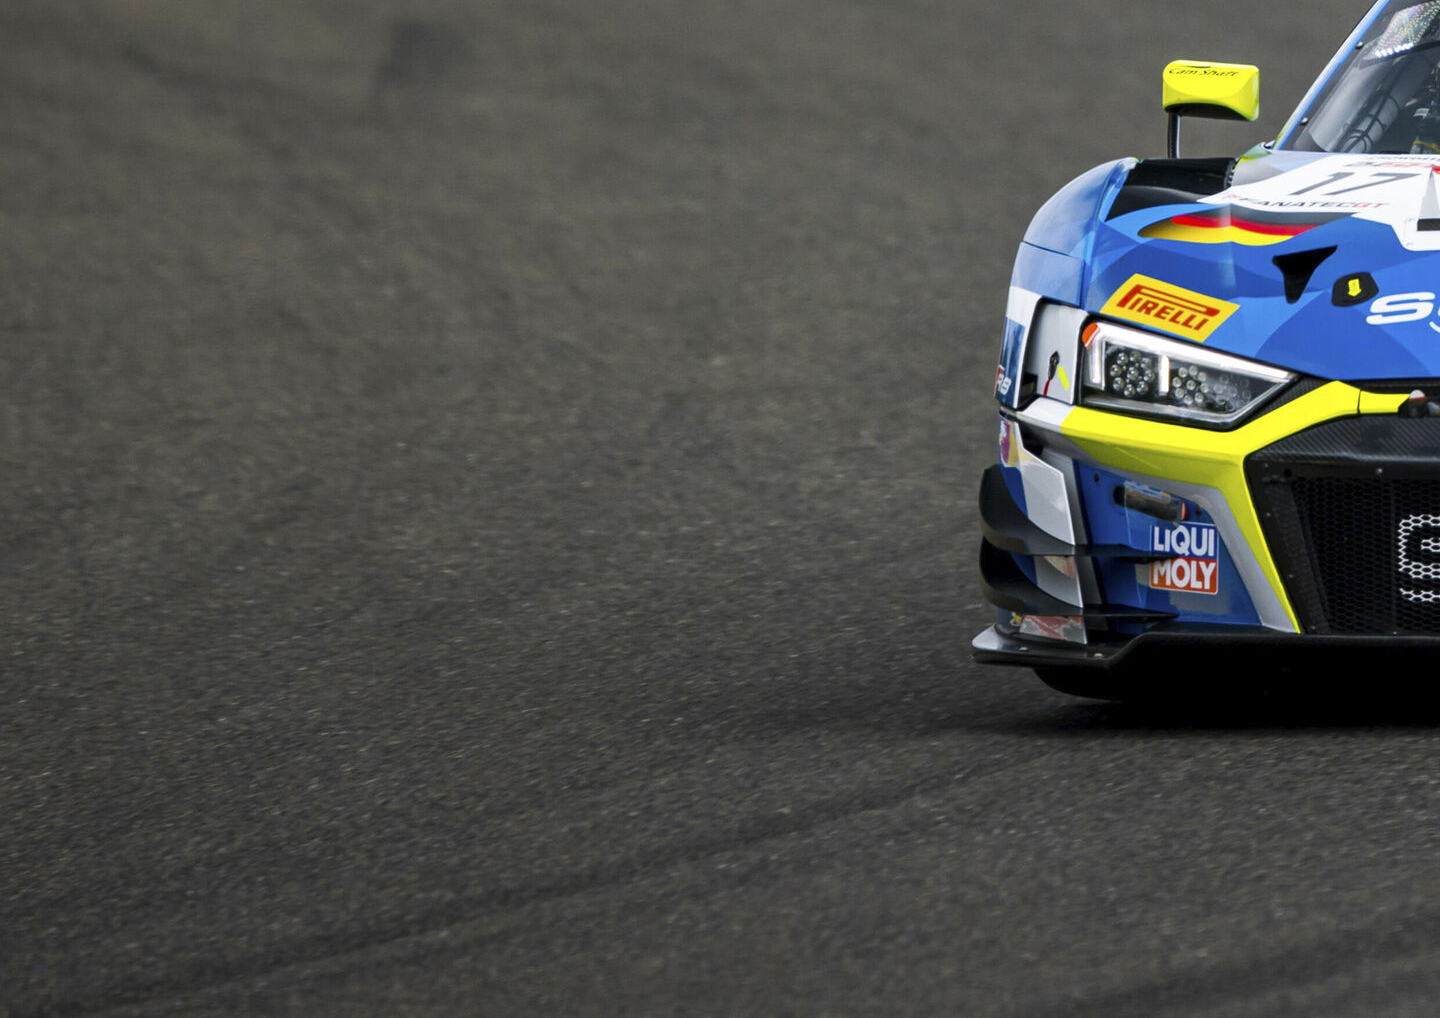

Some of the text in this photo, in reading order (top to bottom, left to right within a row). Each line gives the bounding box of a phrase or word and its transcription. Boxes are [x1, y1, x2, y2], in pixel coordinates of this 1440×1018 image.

[1289, 172, 1422, 196] 17
[1116, 284, 1220, 331] PIRELLI
[1153, 525, 1215, 556] LIQUI
[1152, 558, 1217, 590] MOLY
